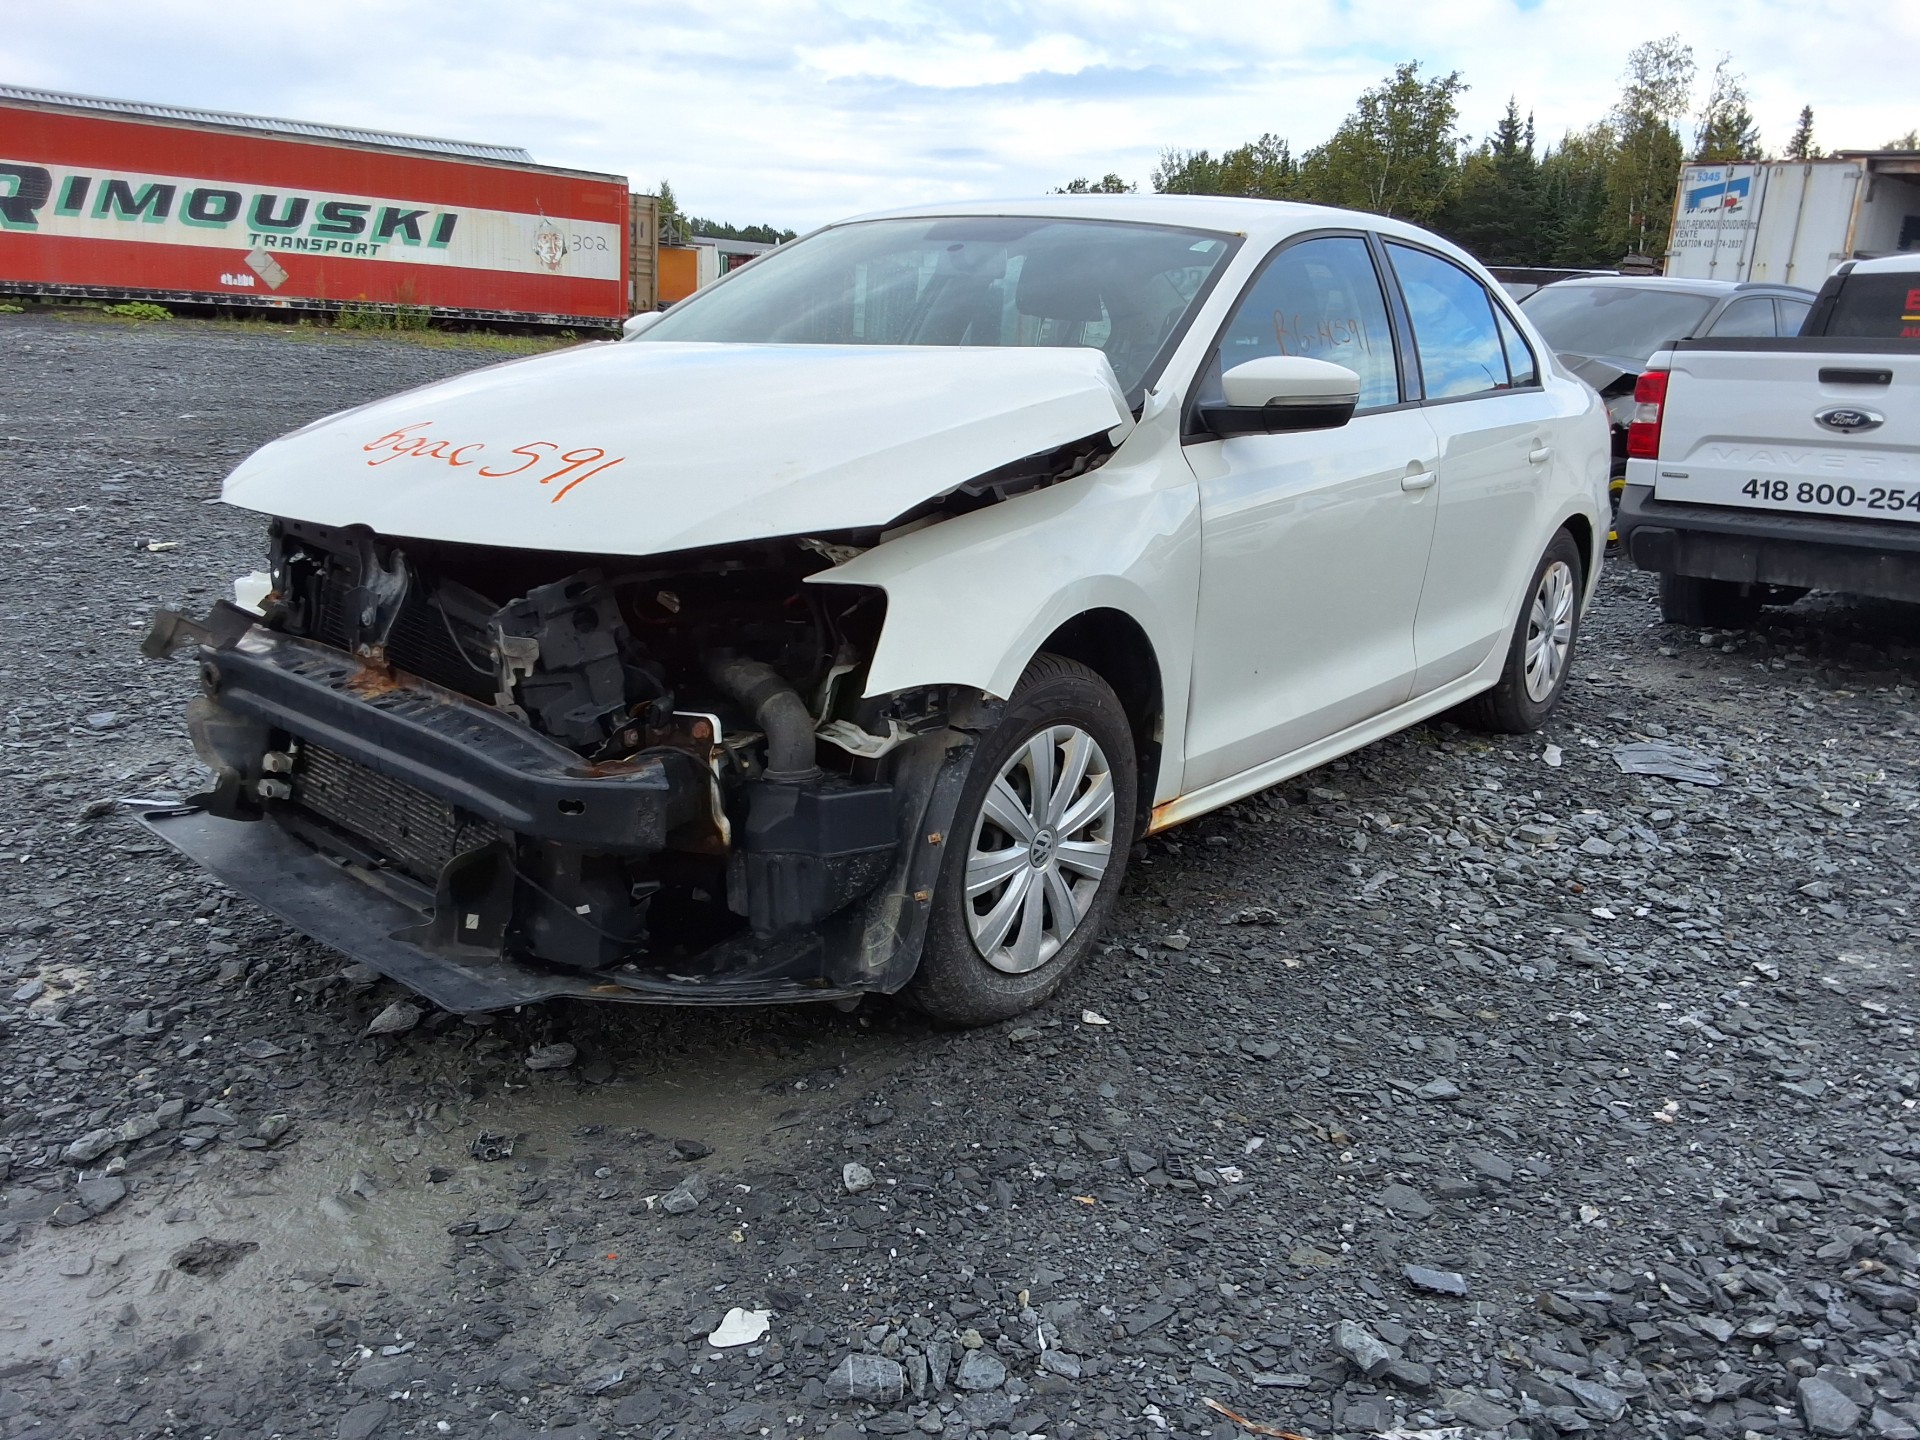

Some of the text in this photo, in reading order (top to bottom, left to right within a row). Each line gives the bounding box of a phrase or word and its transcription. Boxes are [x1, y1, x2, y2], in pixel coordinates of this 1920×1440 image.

[1696, 171, 1721, 182] 5345
[0, 163, 458, 249] RIMOUSKI
[1675, 219, 1721, 230] MULTI-REMORQU
[1675, 230, 1698, 239] VENTE
[249, 233, 382, 256] TRANSPORT
[571, 233, 610, 253] 302
[1673, 239, 1702, 248] LOCATION
[1830, 411, 1861, 425] Ford
[1741, 478, 1920, 513] 418 800-254
